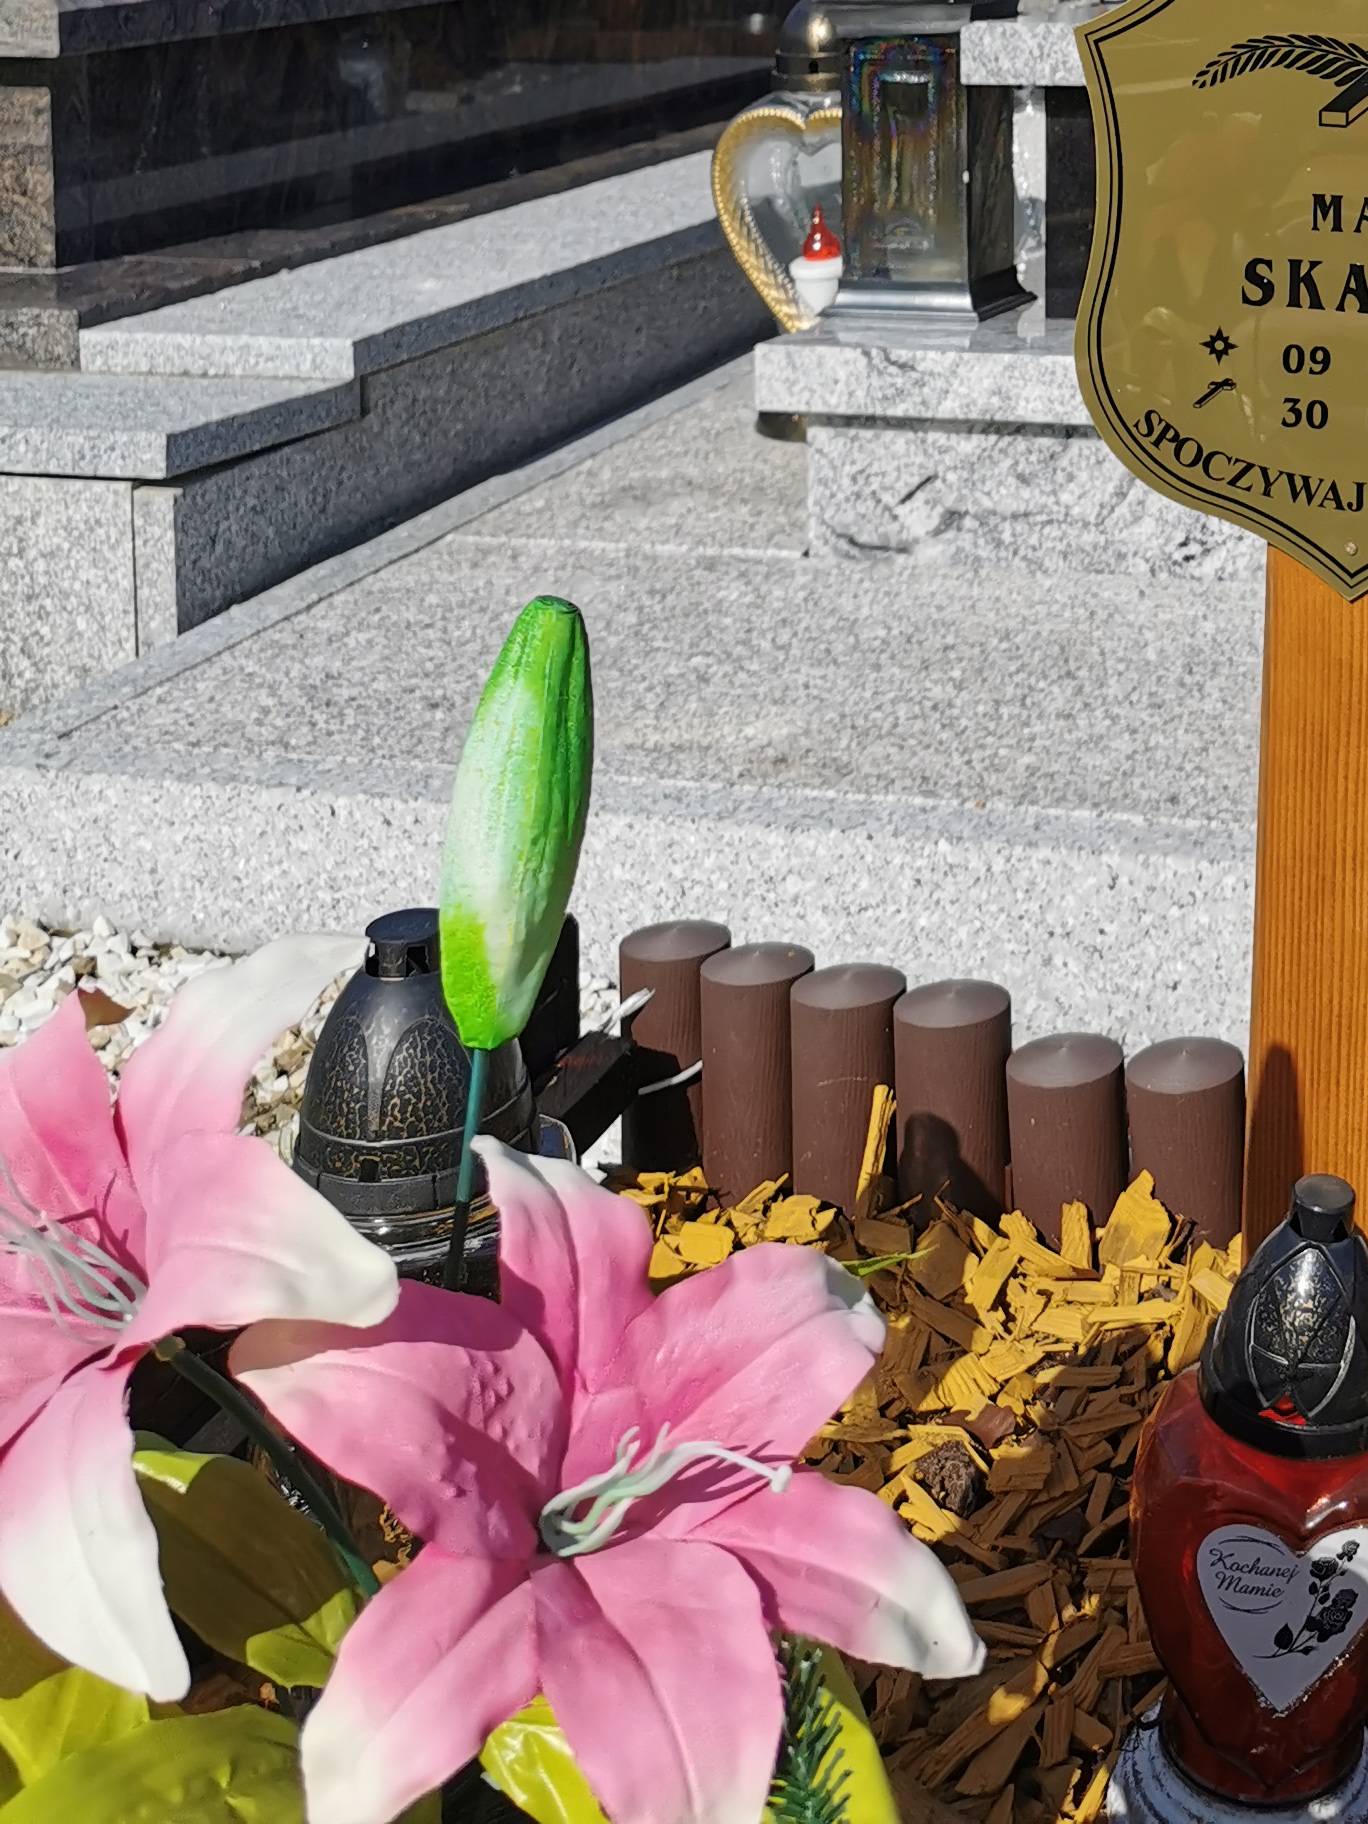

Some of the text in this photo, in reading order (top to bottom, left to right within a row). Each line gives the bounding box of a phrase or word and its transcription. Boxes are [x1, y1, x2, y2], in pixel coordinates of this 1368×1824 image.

[1282, 343, 1332, 376] 09
[1280, 397, 1329, 430] 30
[1132, 409, 1367, 513] SPOCZYWAJ
[1209, 1547, 1300, 1585] Kochanej
